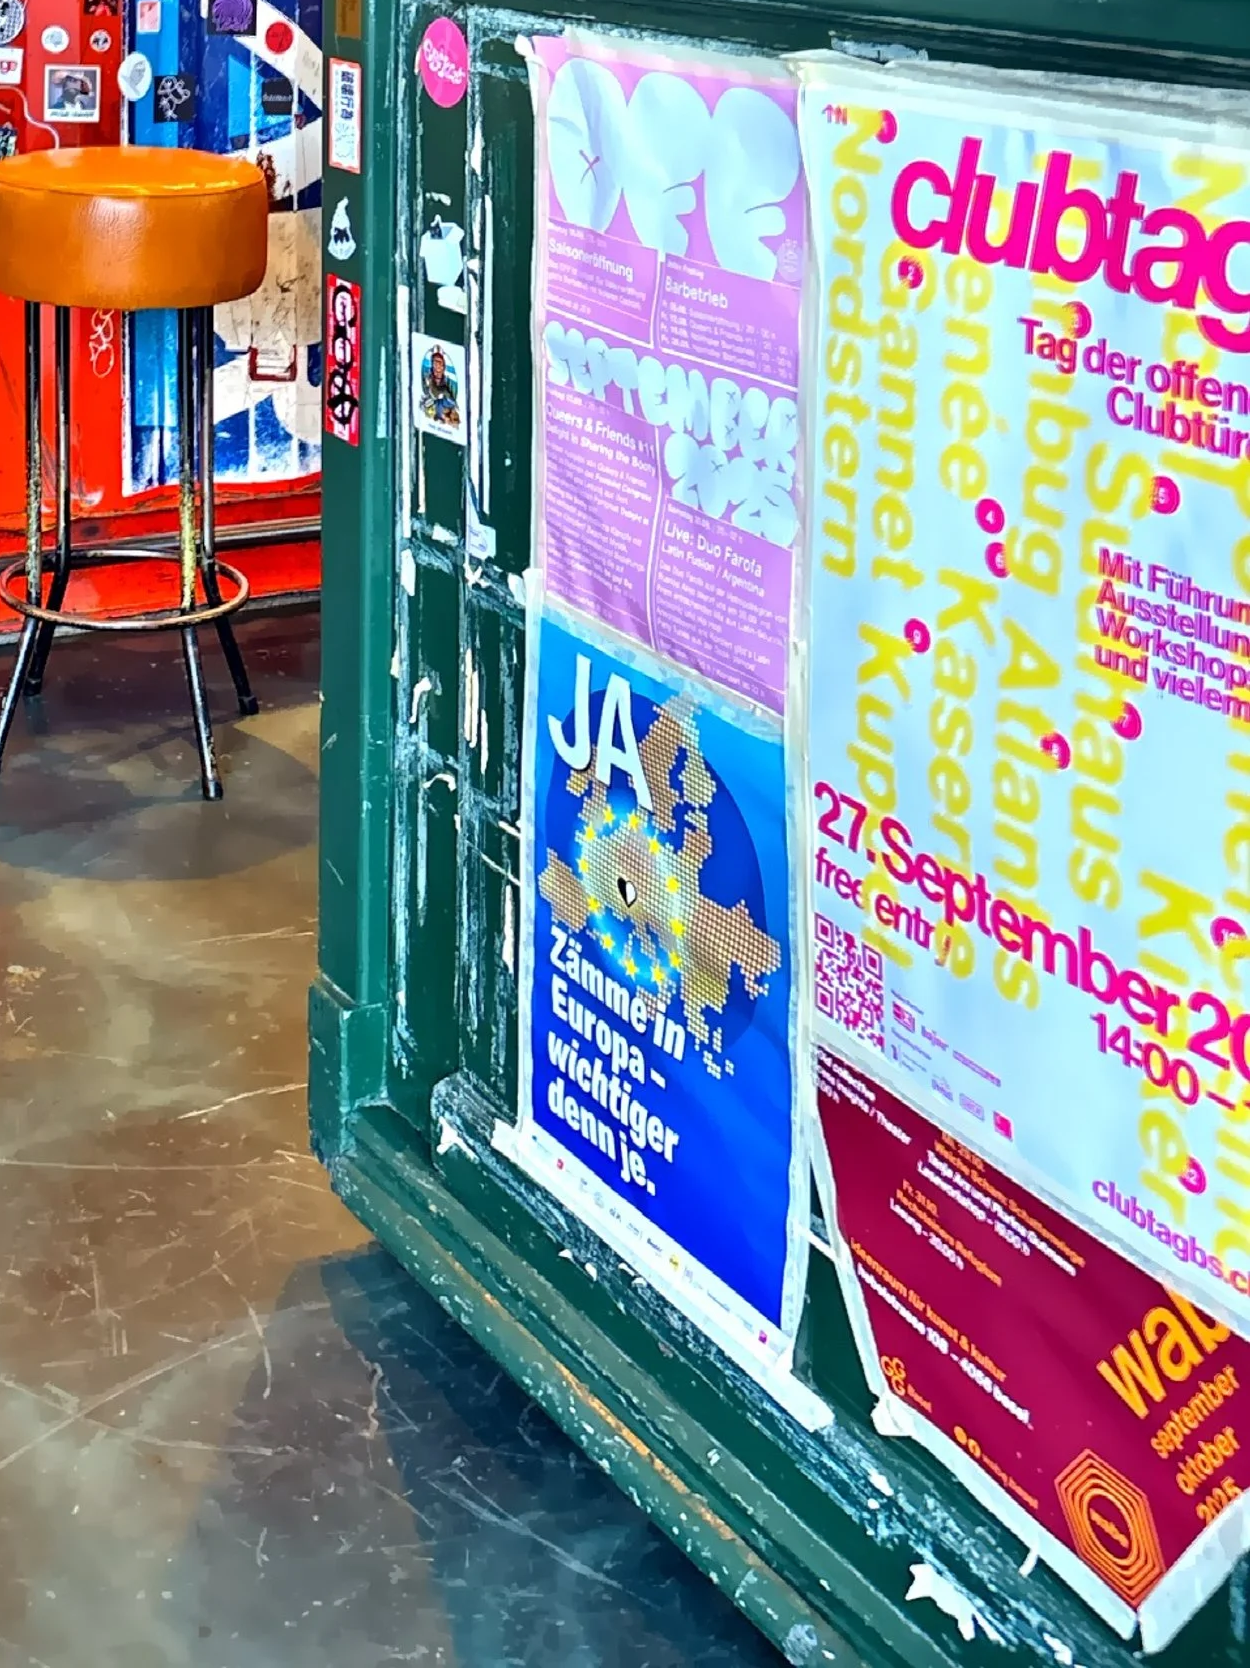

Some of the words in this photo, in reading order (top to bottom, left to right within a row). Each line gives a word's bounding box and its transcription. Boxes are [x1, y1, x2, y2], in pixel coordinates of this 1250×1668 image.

[549, 238, 633, 282] Saisoneröffnung
[665, 275, 728, 309] Barbetrieb
[822, 104, 885, 579] Nordstern
[1017, 316, 1077, 374] Tag
[1082, 338, 1142, 384] der
[1145, 359, 1250, 416] offen
[584, 417, 593, 434] &
[595, 420, 636, 450] Friends
[870, 237, 938, 591] Gannet
[661, 540, 684, 560] Latin
[686, 551, 715, 574] Fusion
[721, 568, 765, 598] Argentina
[664, 519, 694, 546] Live:
[697, 535, 721, 558] Duo
[1098, 547, 1143, 588] Mit
[1094, 644, 1149, 683] und
[547, 652, 655, 815] JA
[814, 846, 865, 909] free
[548, 926, 648, 1033] Zämme
[652, 999, 686, 1061] in
[551, 975, 645, 1084] Europa
[548, 1031, 679, 1164] wichtiger
[1090, 1012, 1200, 1106] 14:00
[547, 1079, 617, 1161] denn
[619, 1131, 656, 1196] je.
[908, 1289, 925, 1311] für
[926, 1304, 959, 1343] kunst
[970, 1343, 1007, 1382] kultur
[1149, 1363, 1240, 1460] september
[1175, 1426, 1240, 1495] oktober
